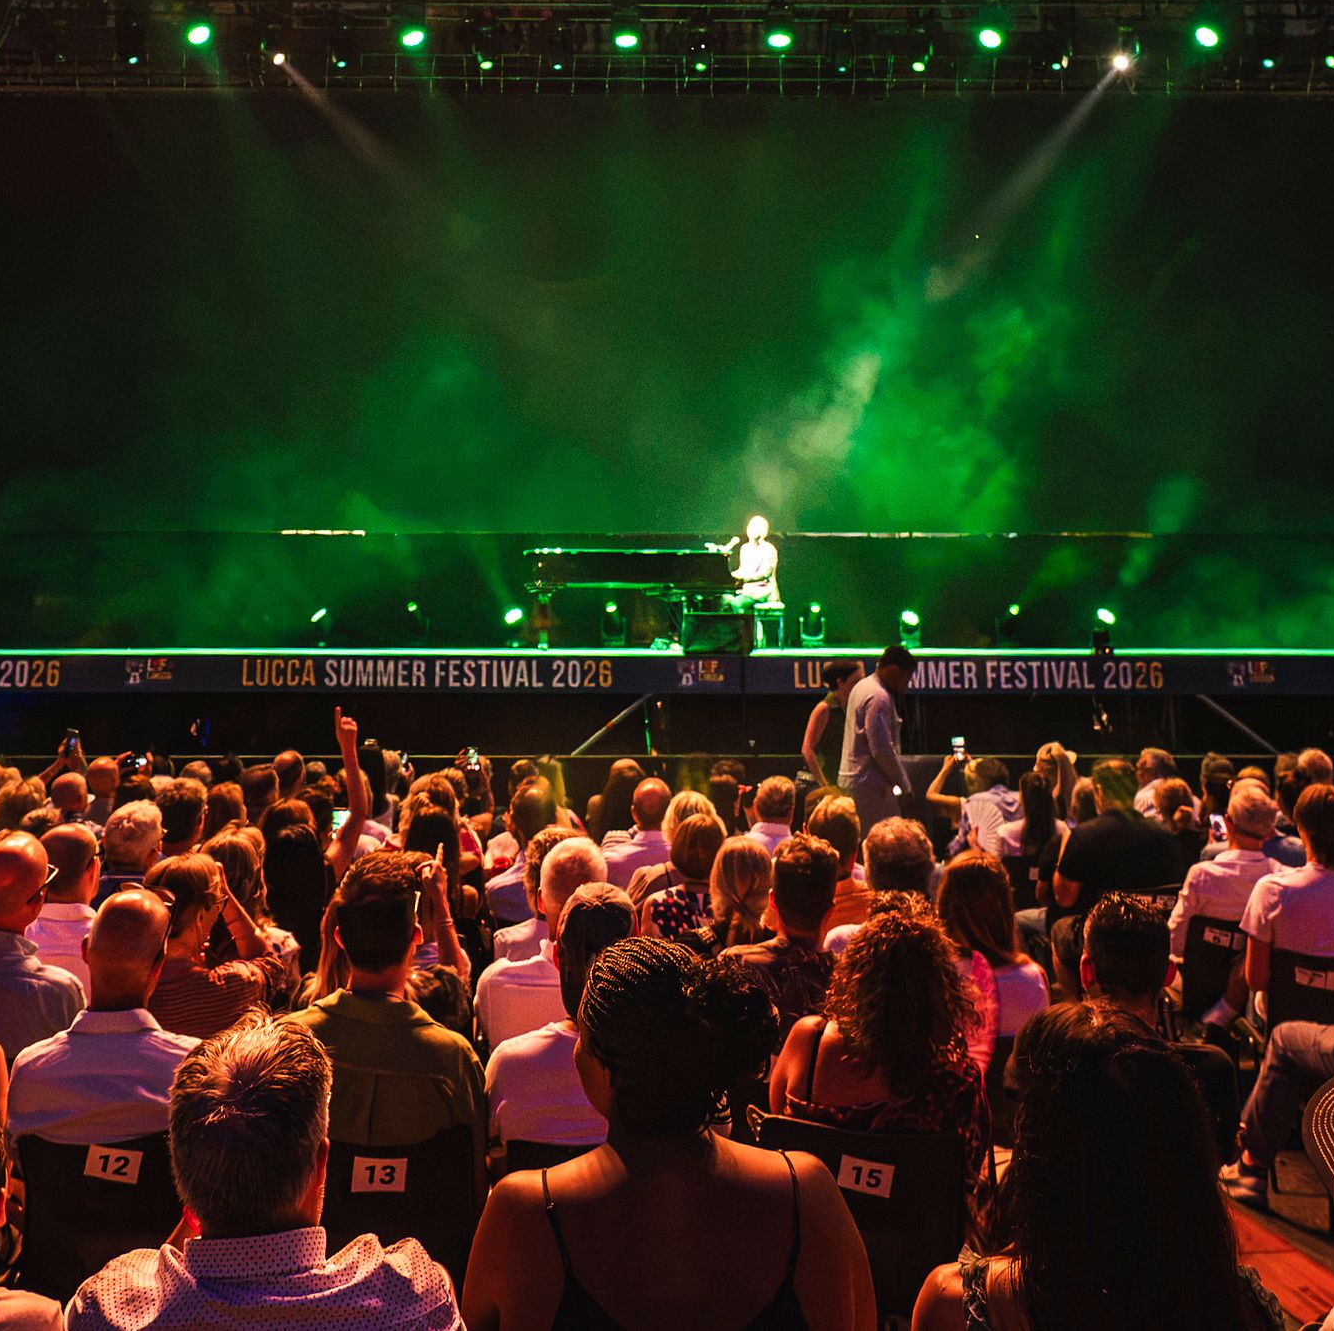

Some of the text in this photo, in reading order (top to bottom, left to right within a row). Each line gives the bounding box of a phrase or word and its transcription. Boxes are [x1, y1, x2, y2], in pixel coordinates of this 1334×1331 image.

[241, 658, 614, 688] LUCCA SUMMER FESTIVAL 2026
[985, 660, 1096, 689] FESTIVAL
[1102, 660, 1164, 689] 2026
[98, 1154, 131, 1177] 12
[364, 1164, 397, 1185] 13
[851, 1166, 883, 1189] 15
